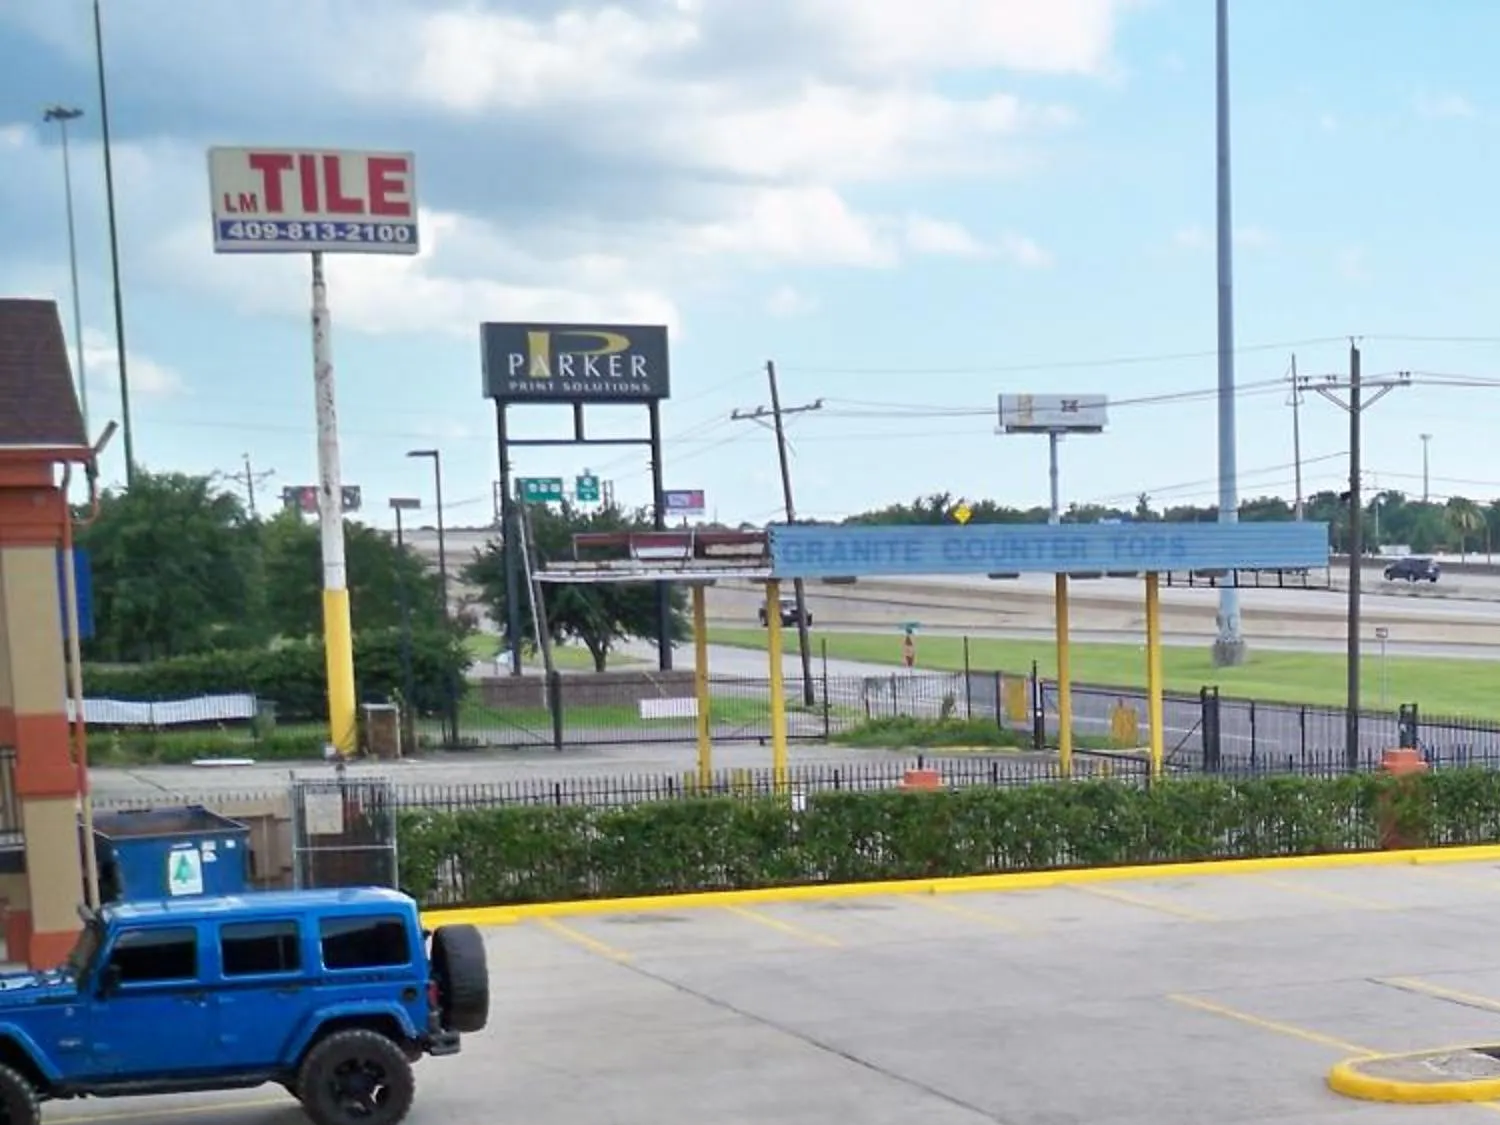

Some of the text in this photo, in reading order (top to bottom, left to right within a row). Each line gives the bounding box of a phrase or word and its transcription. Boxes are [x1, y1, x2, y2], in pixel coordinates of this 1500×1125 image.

[223, 153, 411, 217] LM TILE
[227, 222, 410, 243] 409-813-2100
[508, 352, 648, 378] PARKER
[508, 381, 651, 393] PRINT SOLUTIONS
[782, 535, 1186, 564] GRANITE COUNTER TOPS
